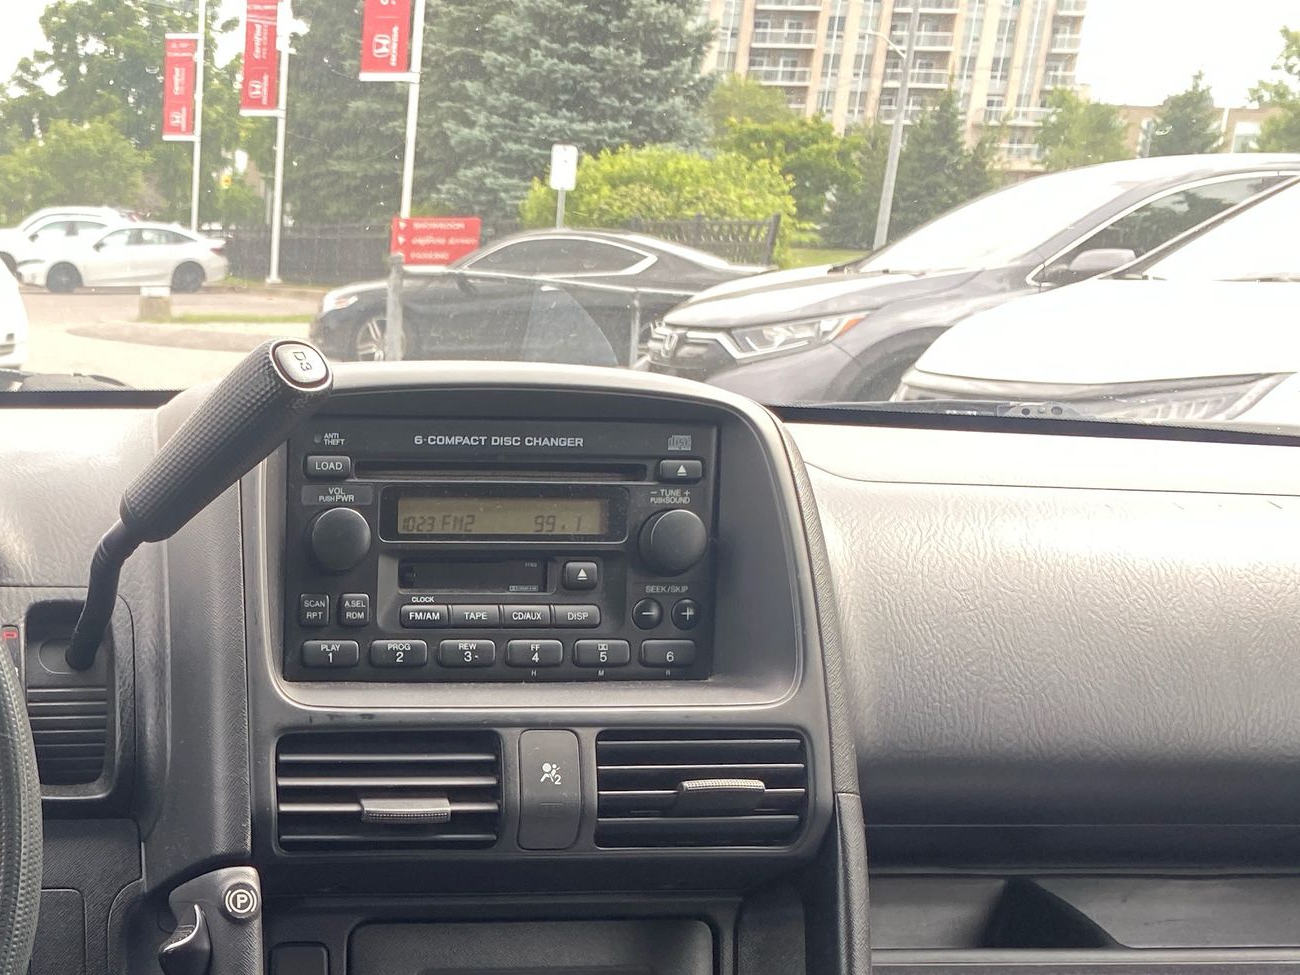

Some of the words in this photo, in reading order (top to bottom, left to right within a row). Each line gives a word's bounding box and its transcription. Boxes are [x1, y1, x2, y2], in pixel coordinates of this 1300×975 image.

[324, 438, 346, 446] THEFT
[491, 436, 521, 446] DISC
[524, 437, 584, 447] CHANGER
[315, 461, 343, 471] LOAD
[328, 487, 346, 495] VOL
[660, 488, 682, 497] TUNE
[335, 494, 355, 502] PWR
[441, 514, 476, 533] FM2
[645, 585, 689, 593] SEEK/SKIP
[303, 600, 326, 608] SCAN
[306, 611, 323, 619] RPT
[346, 611, 365, 620] RDM
[409, 611, 441, 621] FM/AM
[464, 611, 488, 620] TAPE
[512, 611, 542, 620] CD/AUX
[567, 611, 589, 620] DISP
[320, 643, 341, 652] PLAY
[387, 643, 411, 651] PROG
[328, 652, 333, 663] 1
[395, 652, 404, 663] 2
[531, 652, 540, 663] 4
[599, 652, 608, 662] 5
[666, 651, 675, 662] 6
